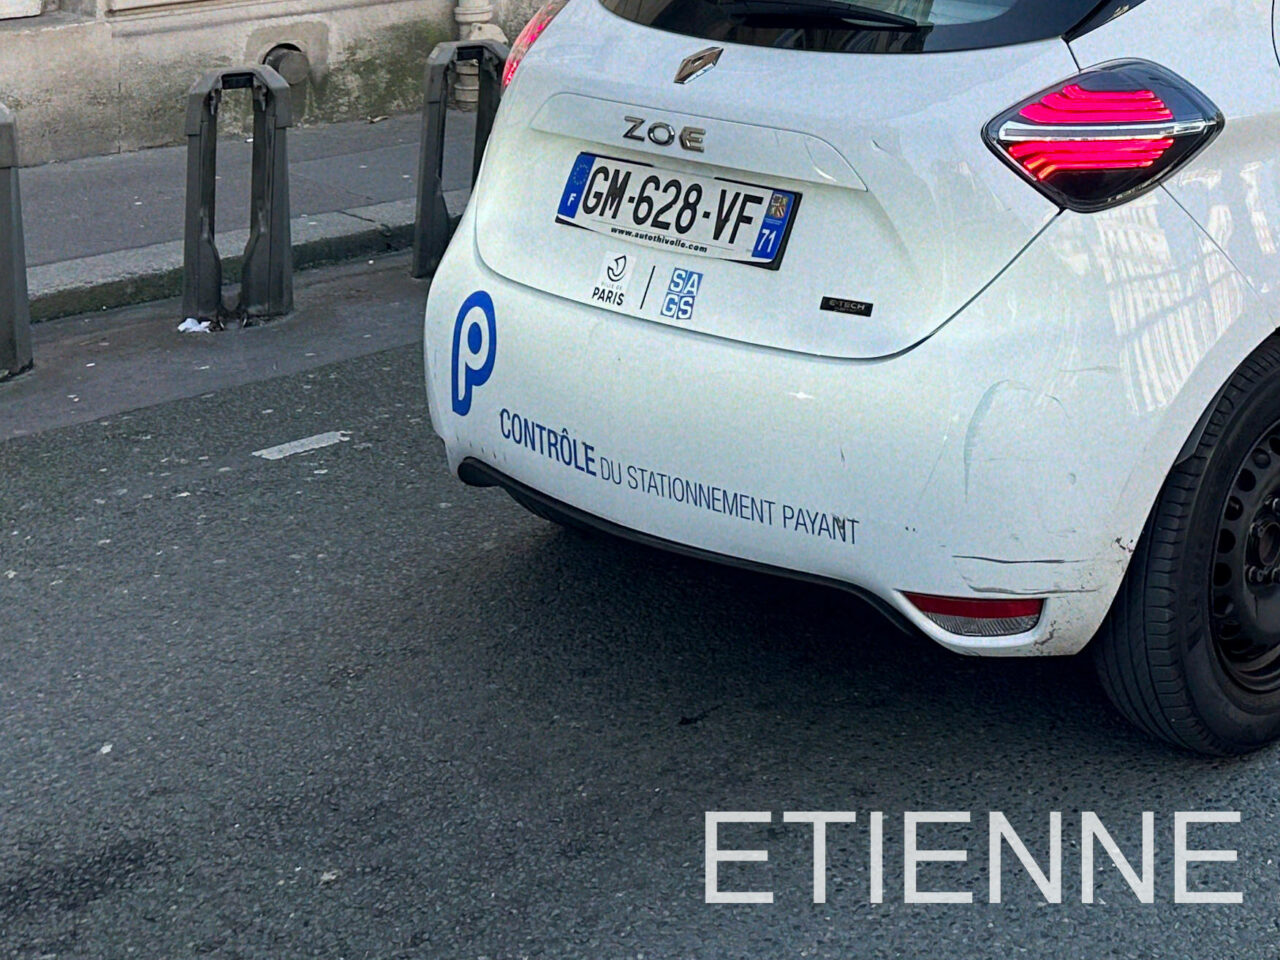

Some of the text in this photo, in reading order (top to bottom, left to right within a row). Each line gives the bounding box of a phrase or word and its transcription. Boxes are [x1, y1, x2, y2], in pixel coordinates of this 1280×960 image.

[623, 116, 706, 152] ZOE
[567, 166, 777, 253] F GM-628-VF 71
[592, 286, 625, 306] PARIS
[500, 408, 860, 545] CONTRÔLE DU STATIONNEMENT PAYANT
